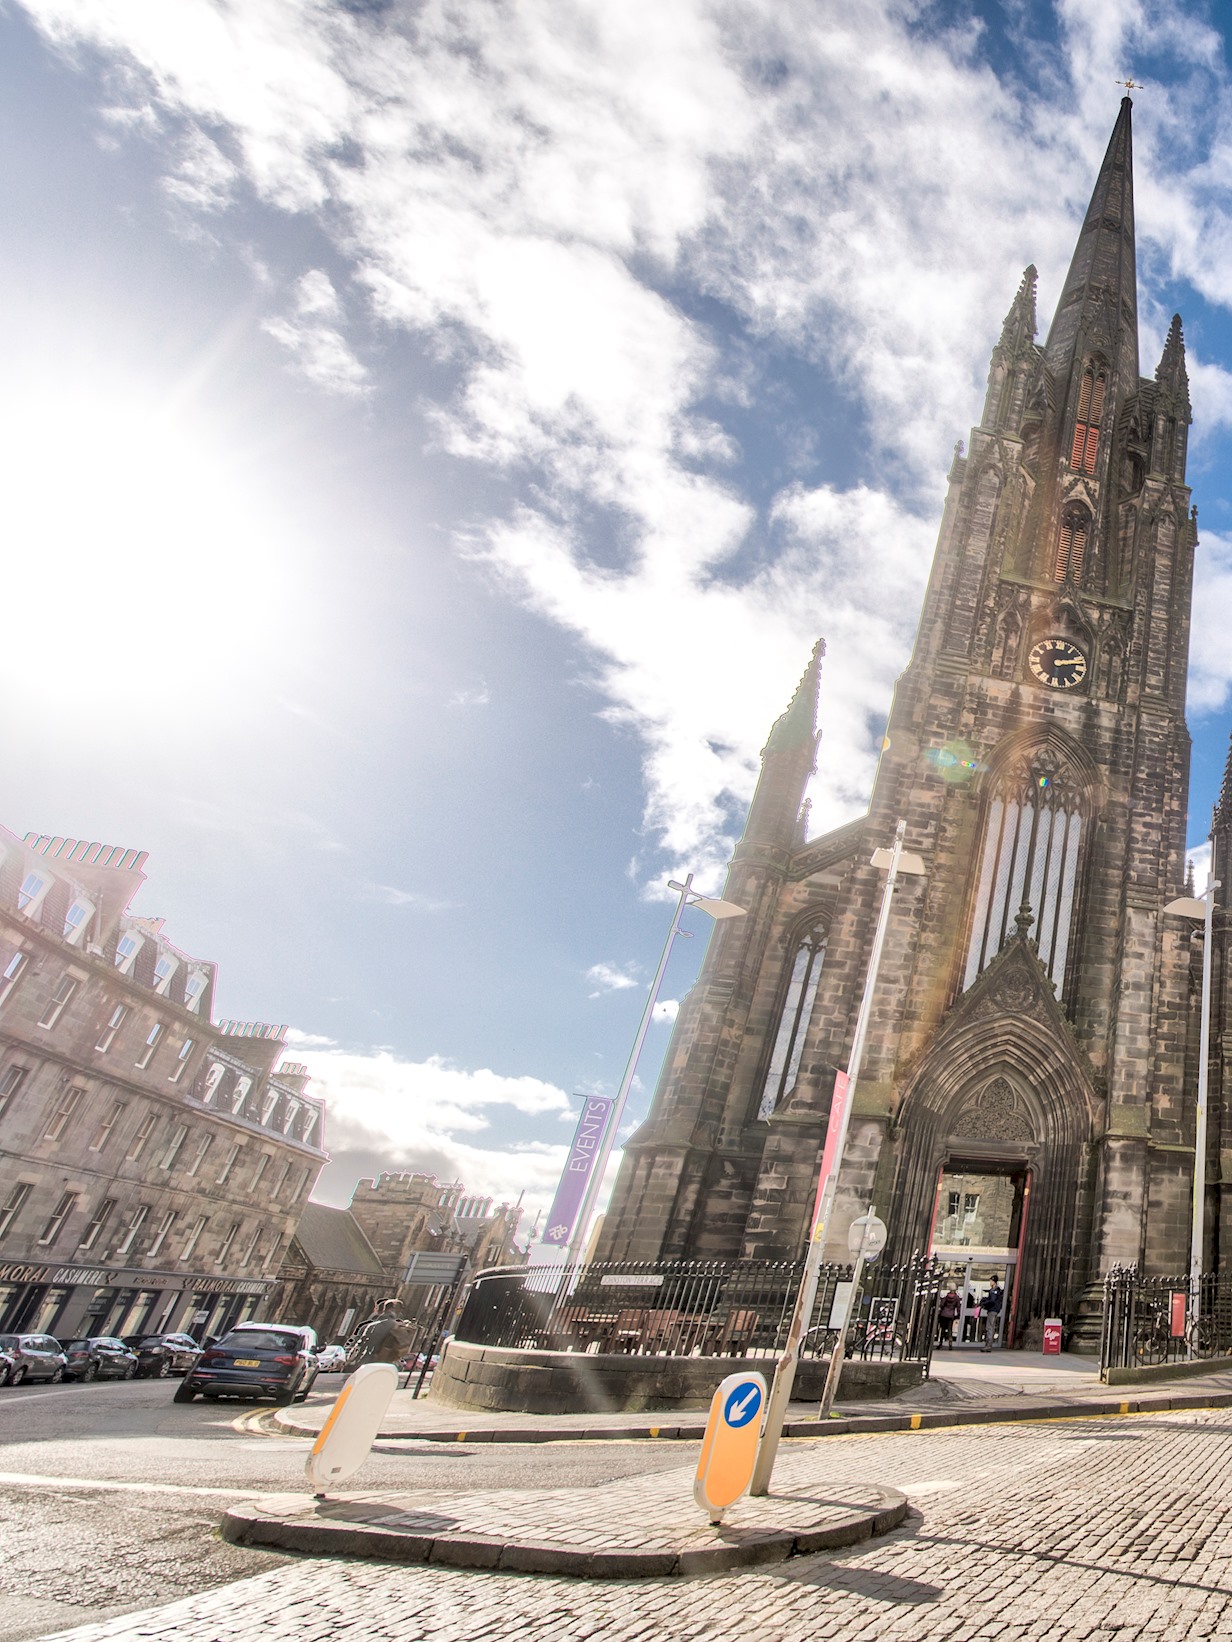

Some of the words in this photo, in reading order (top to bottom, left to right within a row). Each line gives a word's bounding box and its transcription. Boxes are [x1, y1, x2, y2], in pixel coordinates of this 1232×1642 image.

[569, 1101, 606, 1173] EVENTS
[52, 1268, 105, 1285] CASHMERE
[602, 1275, 633, 1285] JOHNSTON
[633, 1275, 663, 1285] TERRACE
[192, 1278, 238, 1293] BALMORAL
